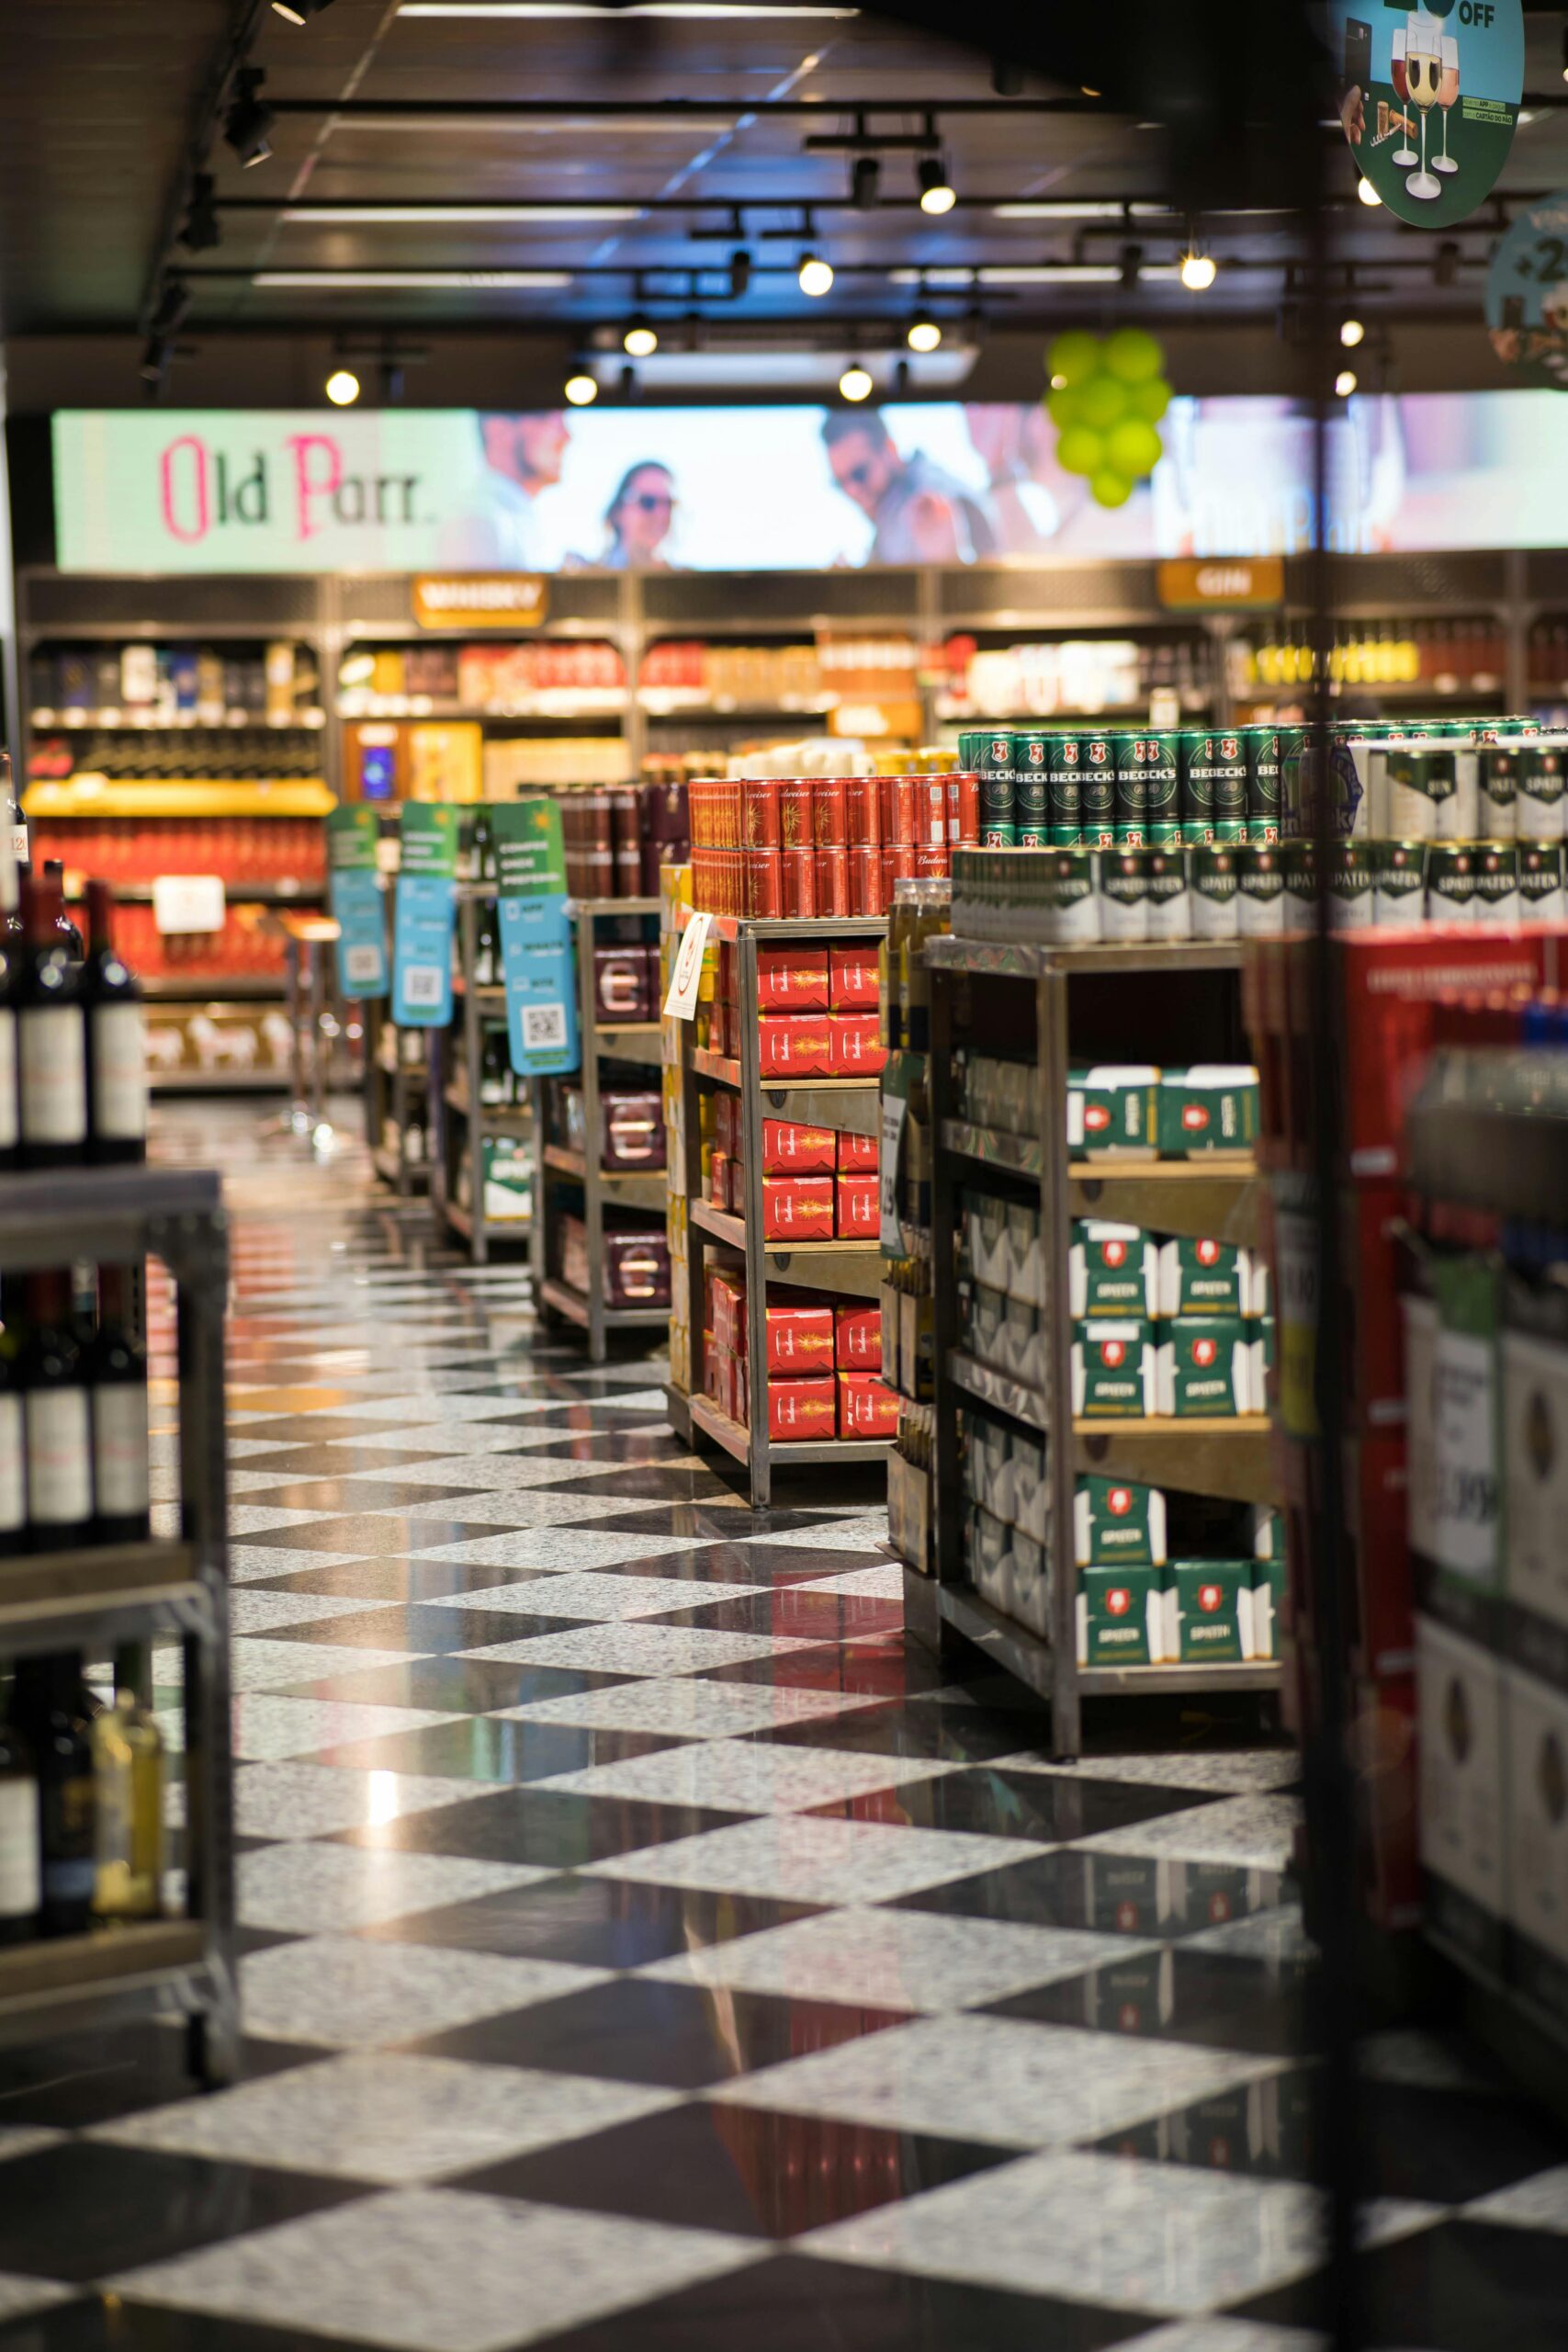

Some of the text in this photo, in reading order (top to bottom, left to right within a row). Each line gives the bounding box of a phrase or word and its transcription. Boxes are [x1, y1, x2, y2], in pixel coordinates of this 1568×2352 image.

[1459, 1, 1495, 28] OFF
[159, 431, 420, 545] Old Parr
